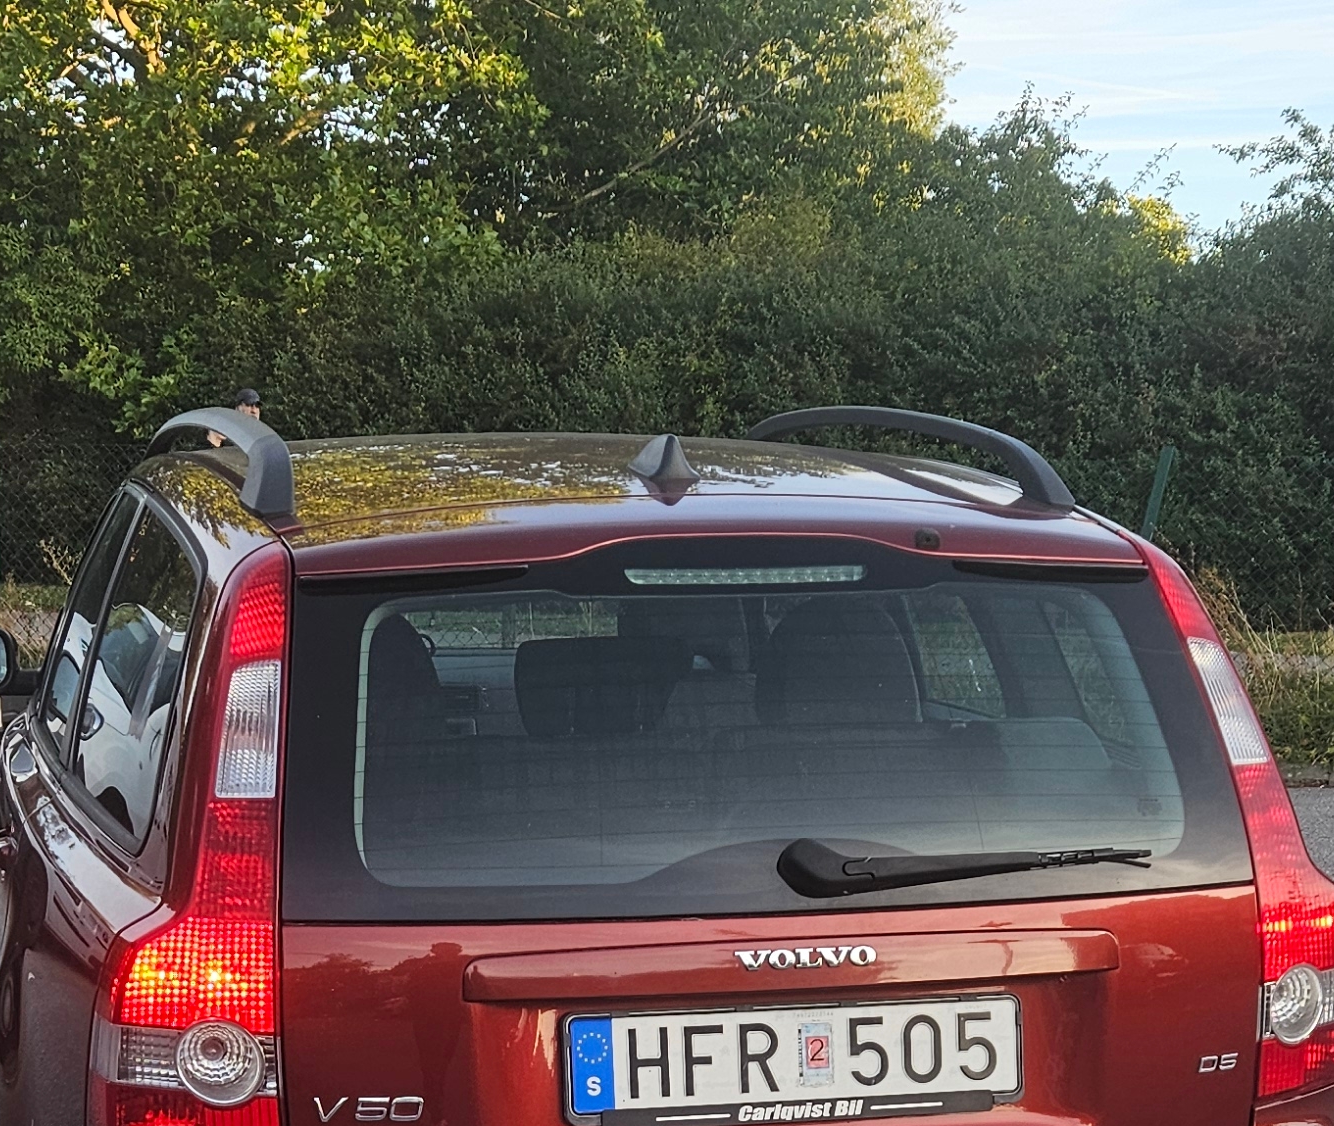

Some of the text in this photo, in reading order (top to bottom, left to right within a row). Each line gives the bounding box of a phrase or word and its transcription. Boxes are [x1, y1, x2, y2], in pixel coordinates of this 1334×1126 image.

[734, 945, 878, 972] VOLVO
[626, 1011, 998, 1099] HFR 505
[810, 1038, 825, 1061] 2
[1198, 1052, 1239, 1073] D5
[586, 1076, 602, 1097] S
[738, 1099, 864, 1122] Carlqvist Bil
